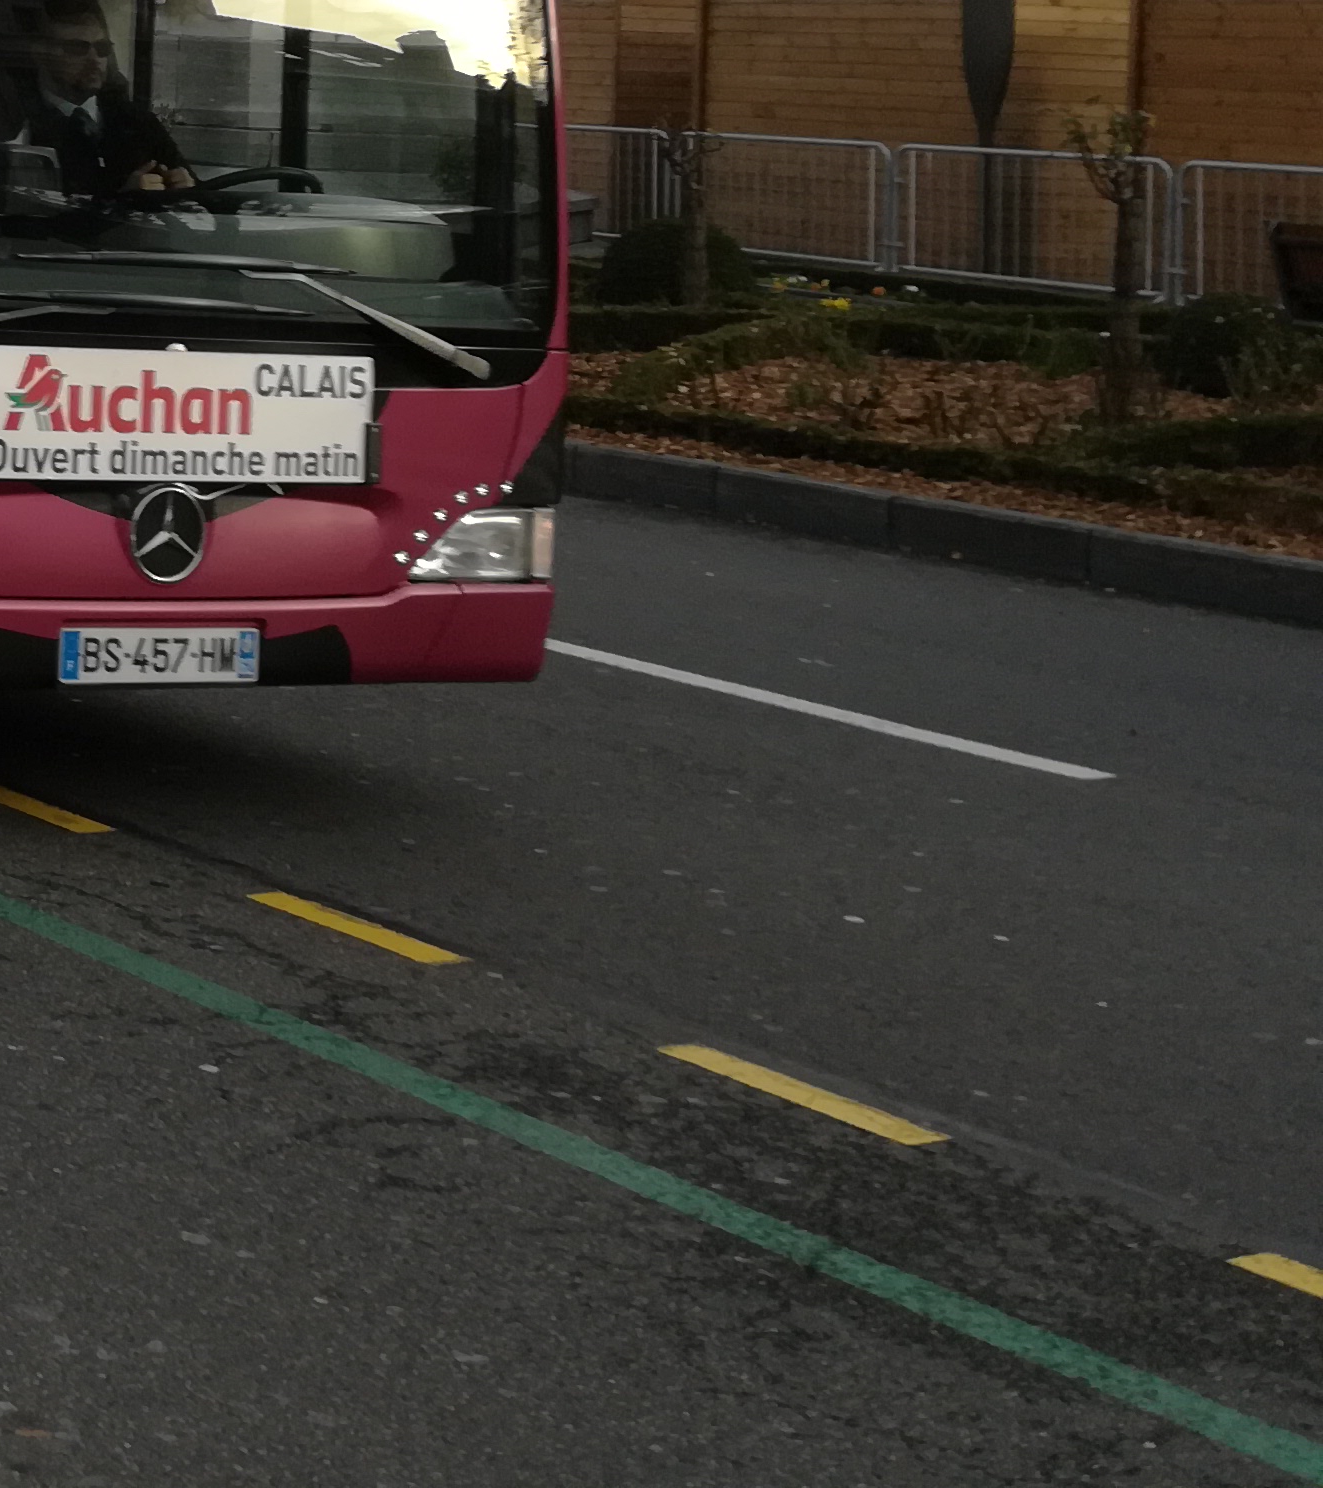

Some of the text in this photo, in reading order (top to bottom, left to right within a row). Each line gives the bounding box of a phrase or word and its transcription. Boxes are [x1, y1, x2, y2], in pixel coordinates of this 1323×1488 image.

[4, 353, 368, 435] Auchan CALAIS
[112, 441, 265, 477] dimanche
[273, 445, 359, 477] matin
